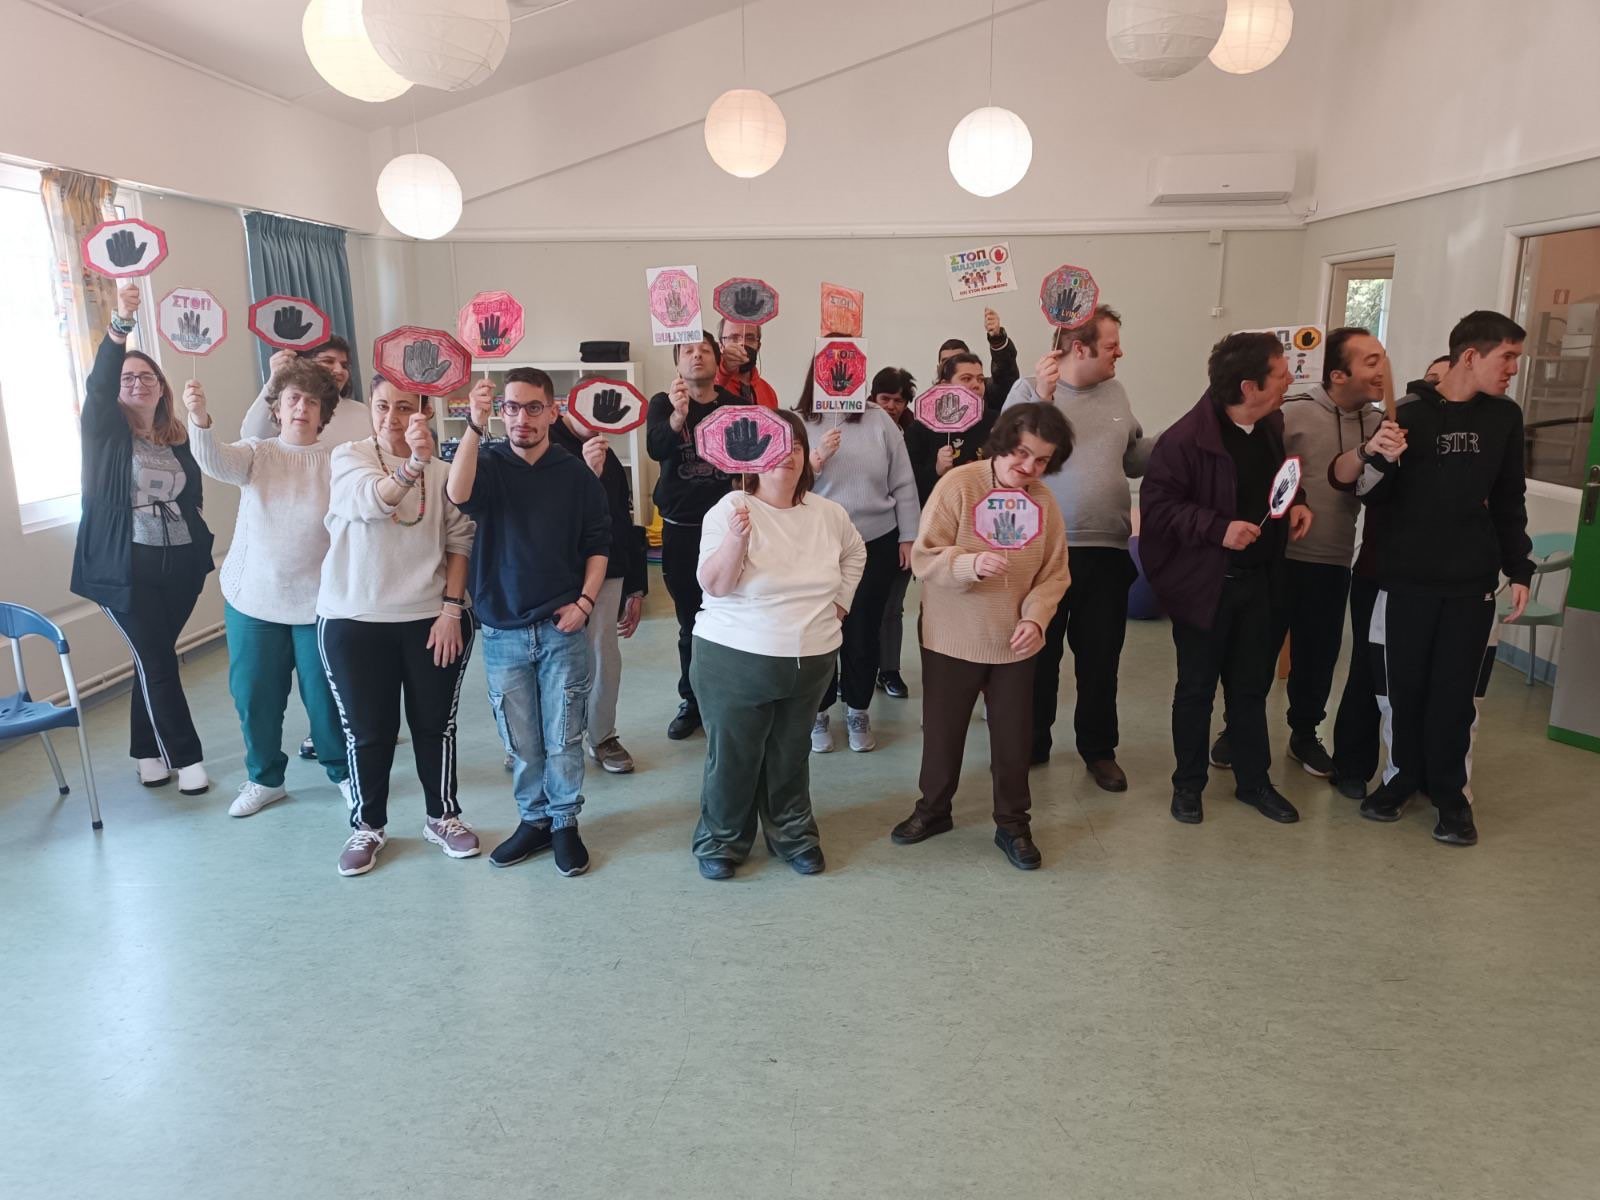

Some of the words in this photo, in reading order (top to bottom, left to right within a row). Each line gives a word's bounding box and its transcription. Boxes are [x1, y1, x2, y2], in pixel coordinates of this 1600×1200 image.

[950, 249, 987, 266] ΣΤΟΠ
[951, 260, 990, 273] BULLYING
[172, 294, 212, 311] ΣΤΟΠ
[655, 330, 701, 343] BULLYING
[815, 400, 863, 411] BULLYING
[1436, 431, 1481, 456] STR
[987, 498, 1027, 510] ΣΤΟΠ
